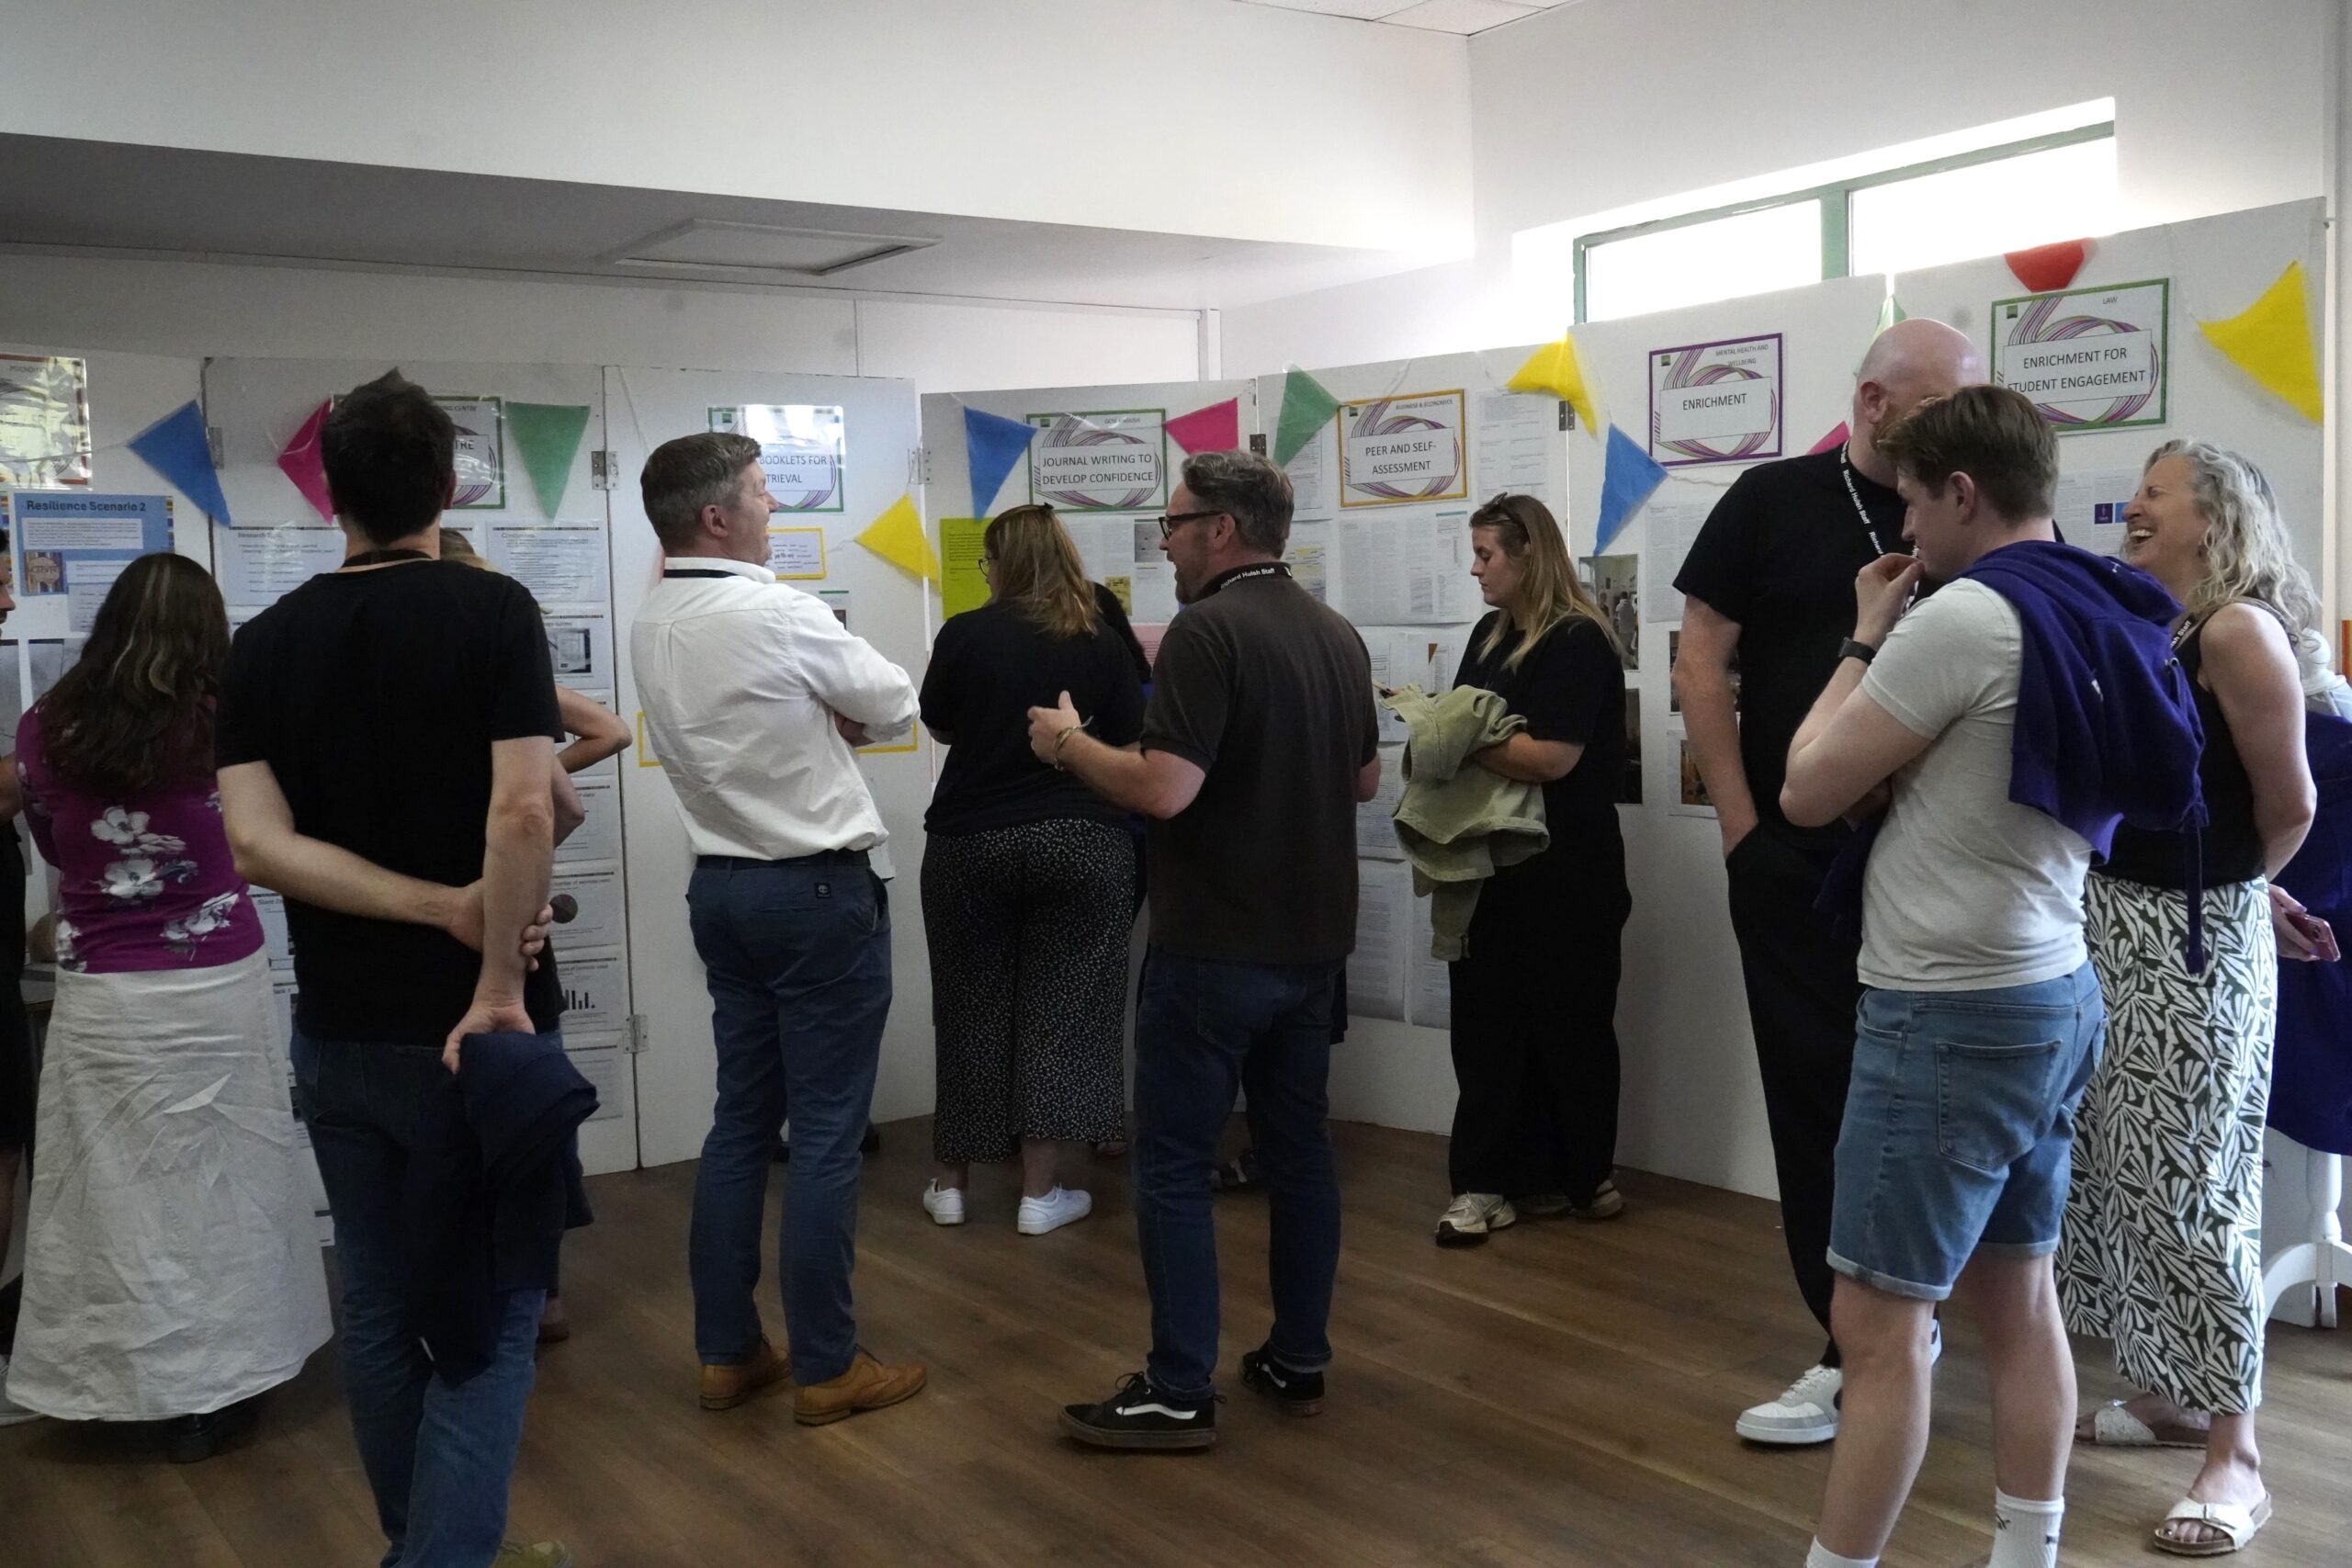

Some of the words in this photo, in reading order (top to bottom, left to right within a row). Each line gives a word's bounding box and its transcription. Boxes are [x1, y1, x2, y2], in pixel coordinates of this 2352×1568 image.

[2102, 297, 2118, 305] LAW
[1715, 347, 1736, 356] MENTAL
[1737, 344, 1757, 354] HEALTH
[1728, 357, 1757, 367] WELLBEING
[2023, 350, 2100, 368] ENRICHMENT
[2104, 347, 2127, 361] FOR
[2007, 378, 2057, 393] STUDENT
[2061, 370, 2146, 389] ENGAGEMENT
[1682, 393, 1747, 411] ENRICHMENT
[1365, 446, 1388, 456] PEER
[1390, 444, 1410, 454] AND
[1412, 442, 1437, 452] SELF-
[759, 455, 807, 465] BOOKLETS
[808, 455, 828, 465] FOR
[1043, 457, 1089, 467] JOURNAL
[1091, 454, 1136, 464] WRITING
[1138, 454, 1152, 463] TO
[1372, 460, 1431, 475] ASSESSMENT
[765, 474, 803, 483] TRIEVAL
[1043, 474, 1087, 485] DEVELOP
[1089, 471, 1154, 483] CONFIDENCE
[26, 501, 87, 511] Resilience
[89, 502, 138, 511] Scenario
[140, 502, 147, 511] 2
[1859, 510, 1871, 525] Staff
[2177, 620, 2192, 637] Staff
